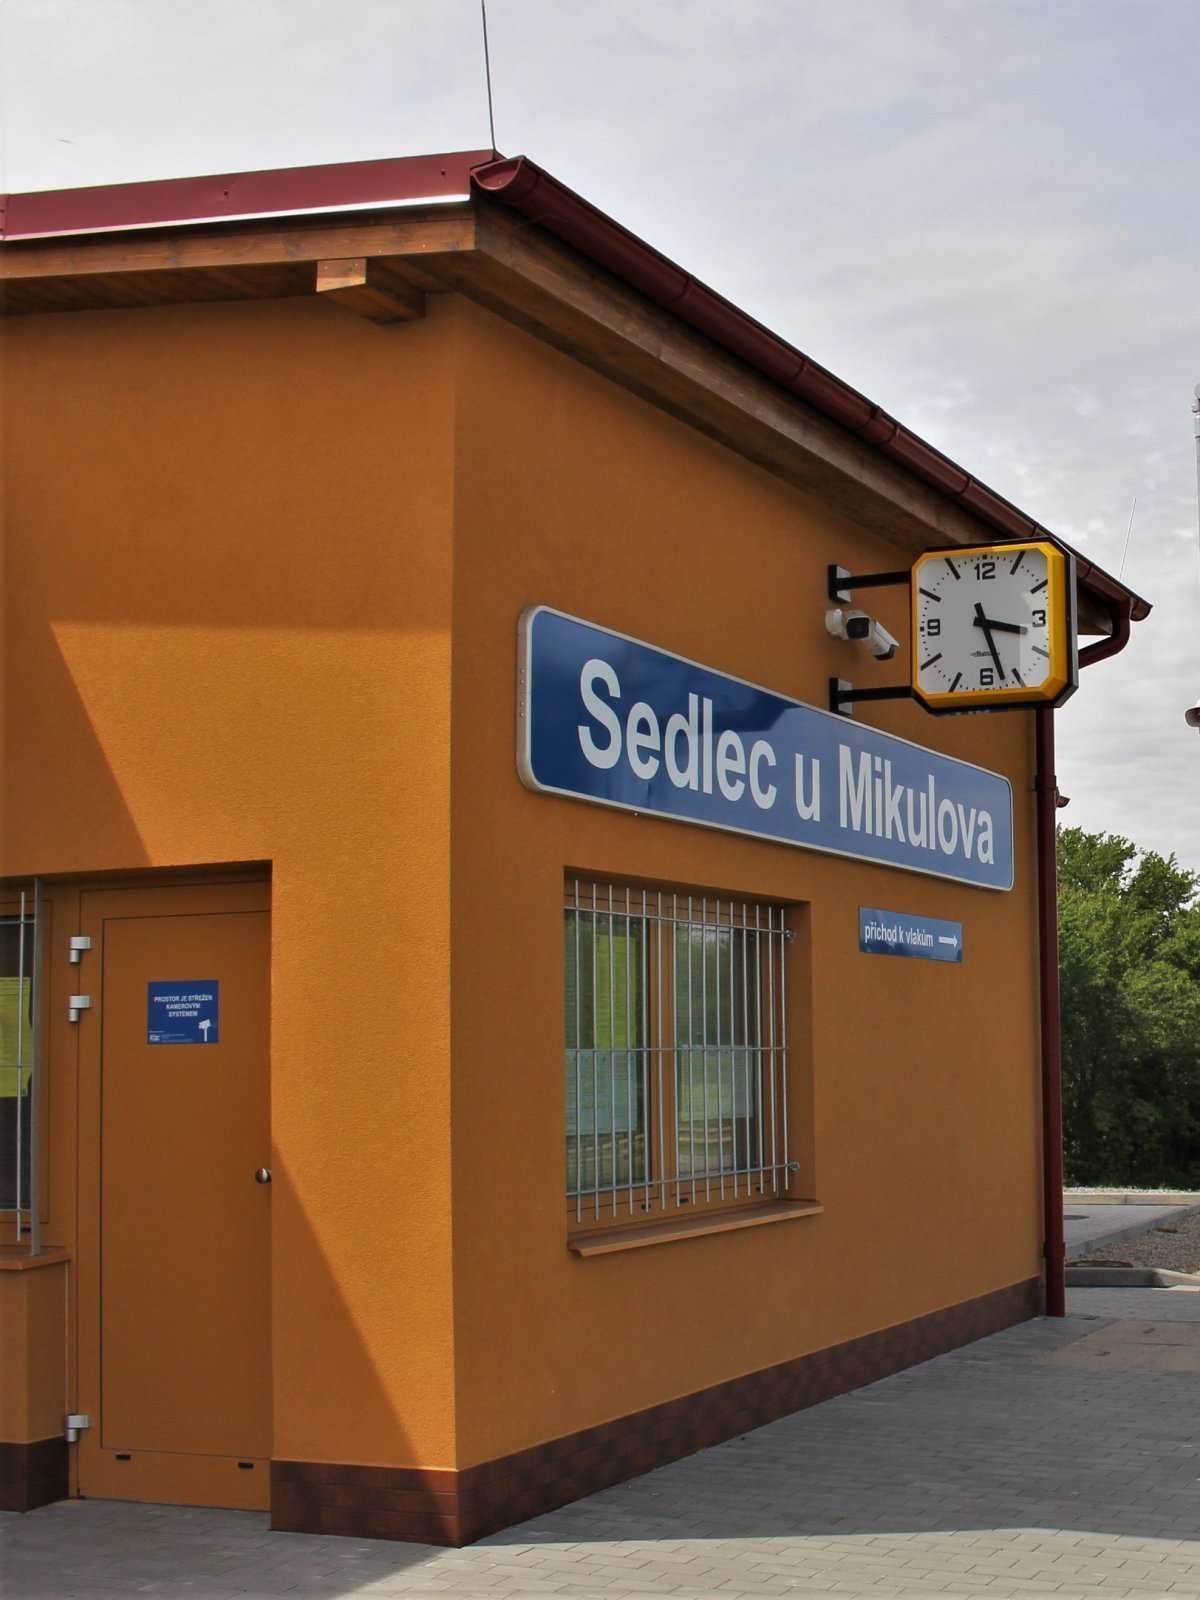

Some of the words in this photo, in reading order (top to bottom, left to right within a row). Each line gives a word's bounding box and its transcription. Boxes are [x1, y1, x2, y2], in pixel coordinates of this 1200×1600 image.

[974, 562, 996, 580] 12
[927, 618, 940, 636] 9
[1032, 609, 1046, 627] 3
[980, 667, 993, 686] 6
[578, 658, 777, 810] Sedlec
[795, 752, 821, 822] u
[839, 743, 994, 865] Mikulova
[865, 921, 897, 943] příchod
[899, 925, 904, 943] k
[906, 927, 933, 947] vlakům
